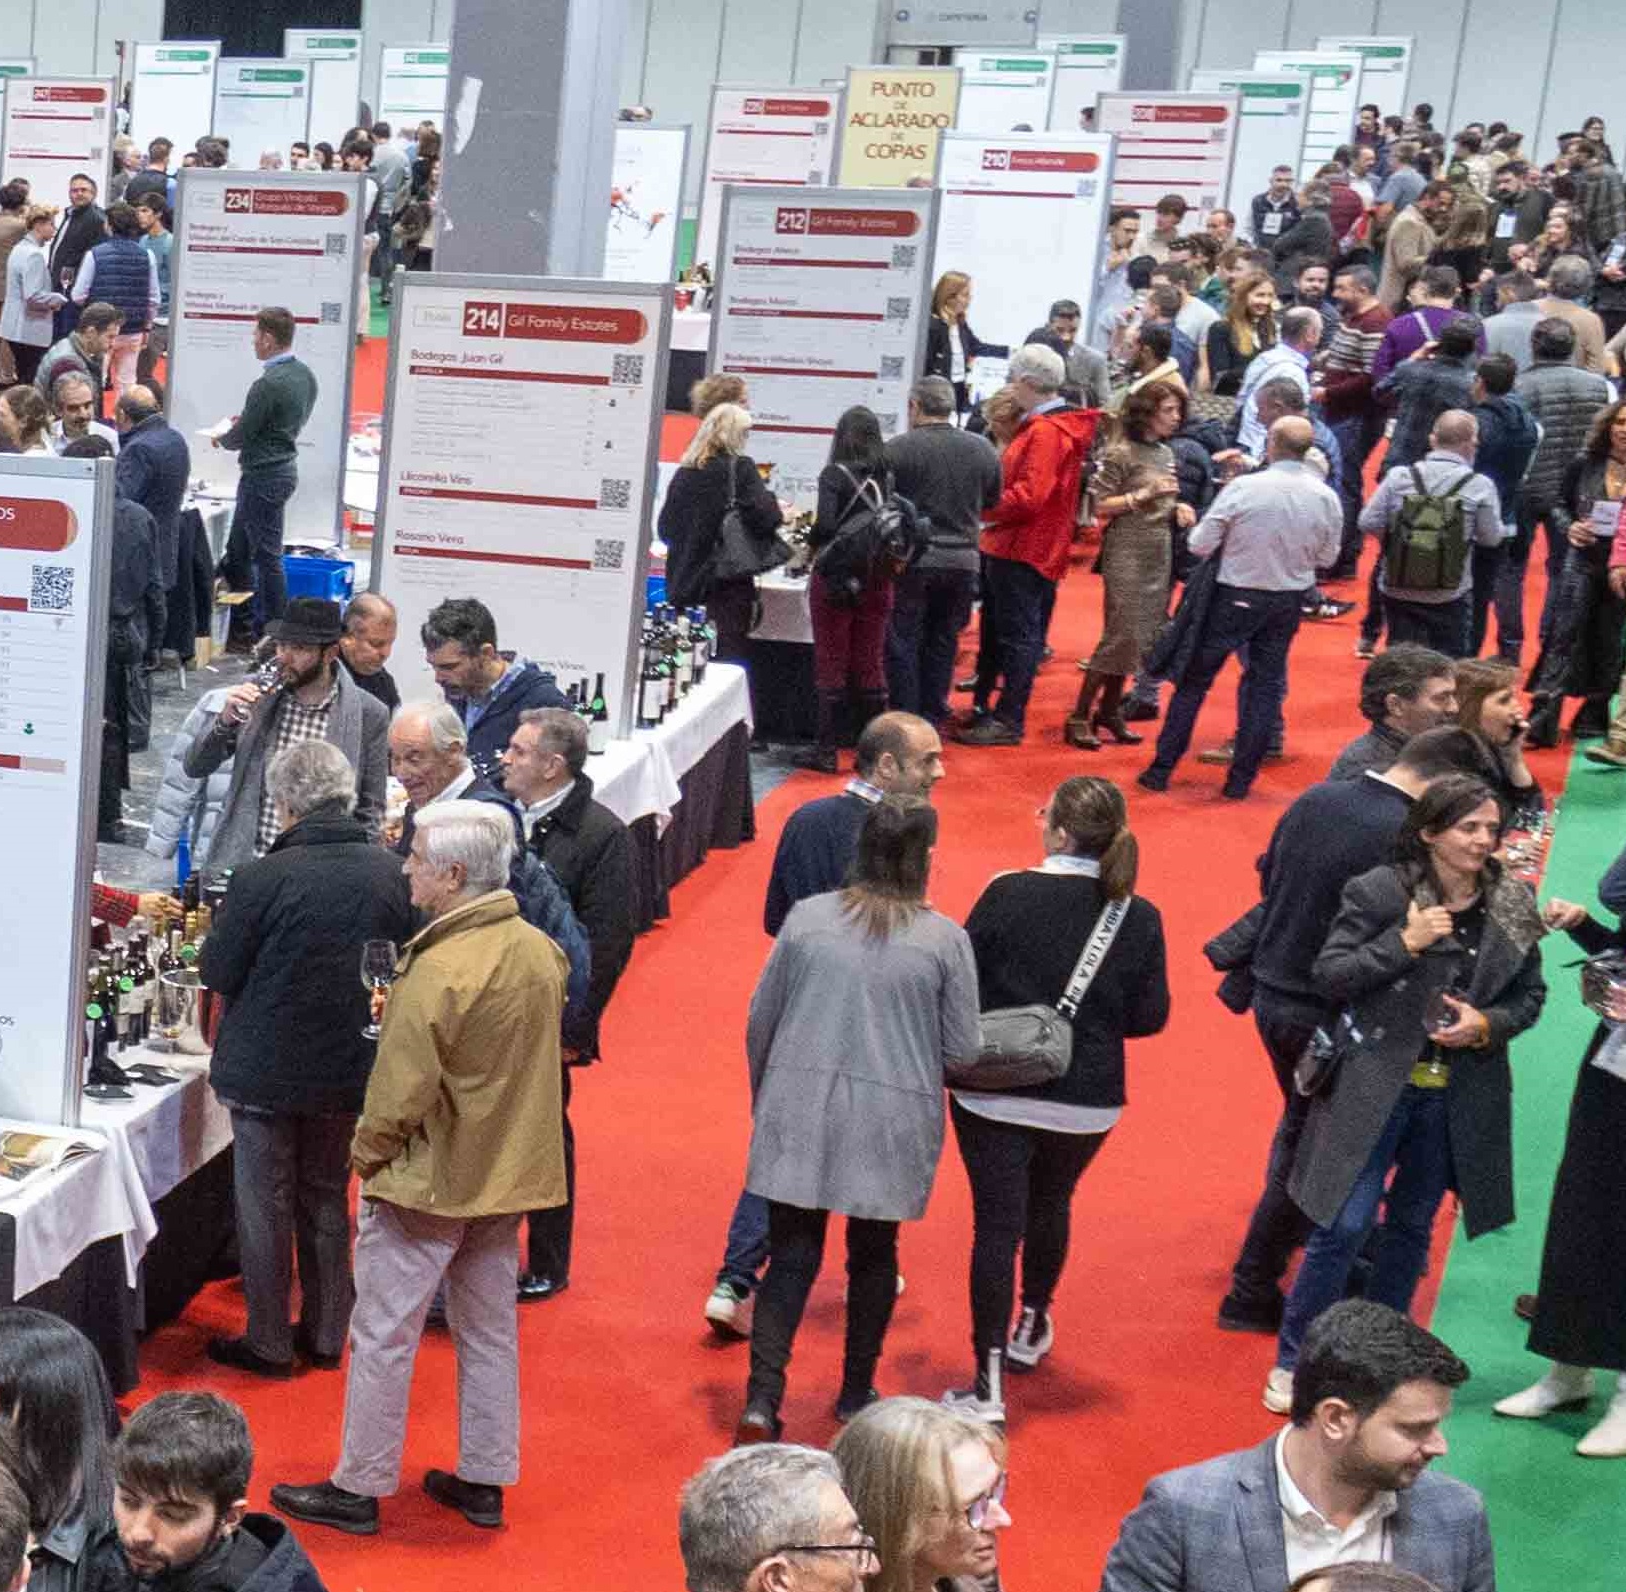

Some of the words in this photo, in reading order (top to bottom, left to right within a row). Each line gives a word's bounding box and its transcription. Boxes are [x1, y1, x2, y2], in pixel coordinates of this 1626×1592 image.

[871, 81, 935, 97] PUNTO
[850, 112, 949, 128] ACLARADO
[865, 144, 927, 160] COPAS
[983, 152, 1006, 167] 210
[226, 192, 249, 209] 234
[778, 212, 805, 230] 212
[465, 309, 499, 330] 214
[508, 314, 525, 327] Gil
[527, 315, 568, 331] Family
[571, 317, 619, 333] Estates
[410, 349, 457, 365] Bodegas
[460, 351, 486, 364] Juan
[489, 352, 503, 364] Gil
[437, 531, 464, 544] Vera
